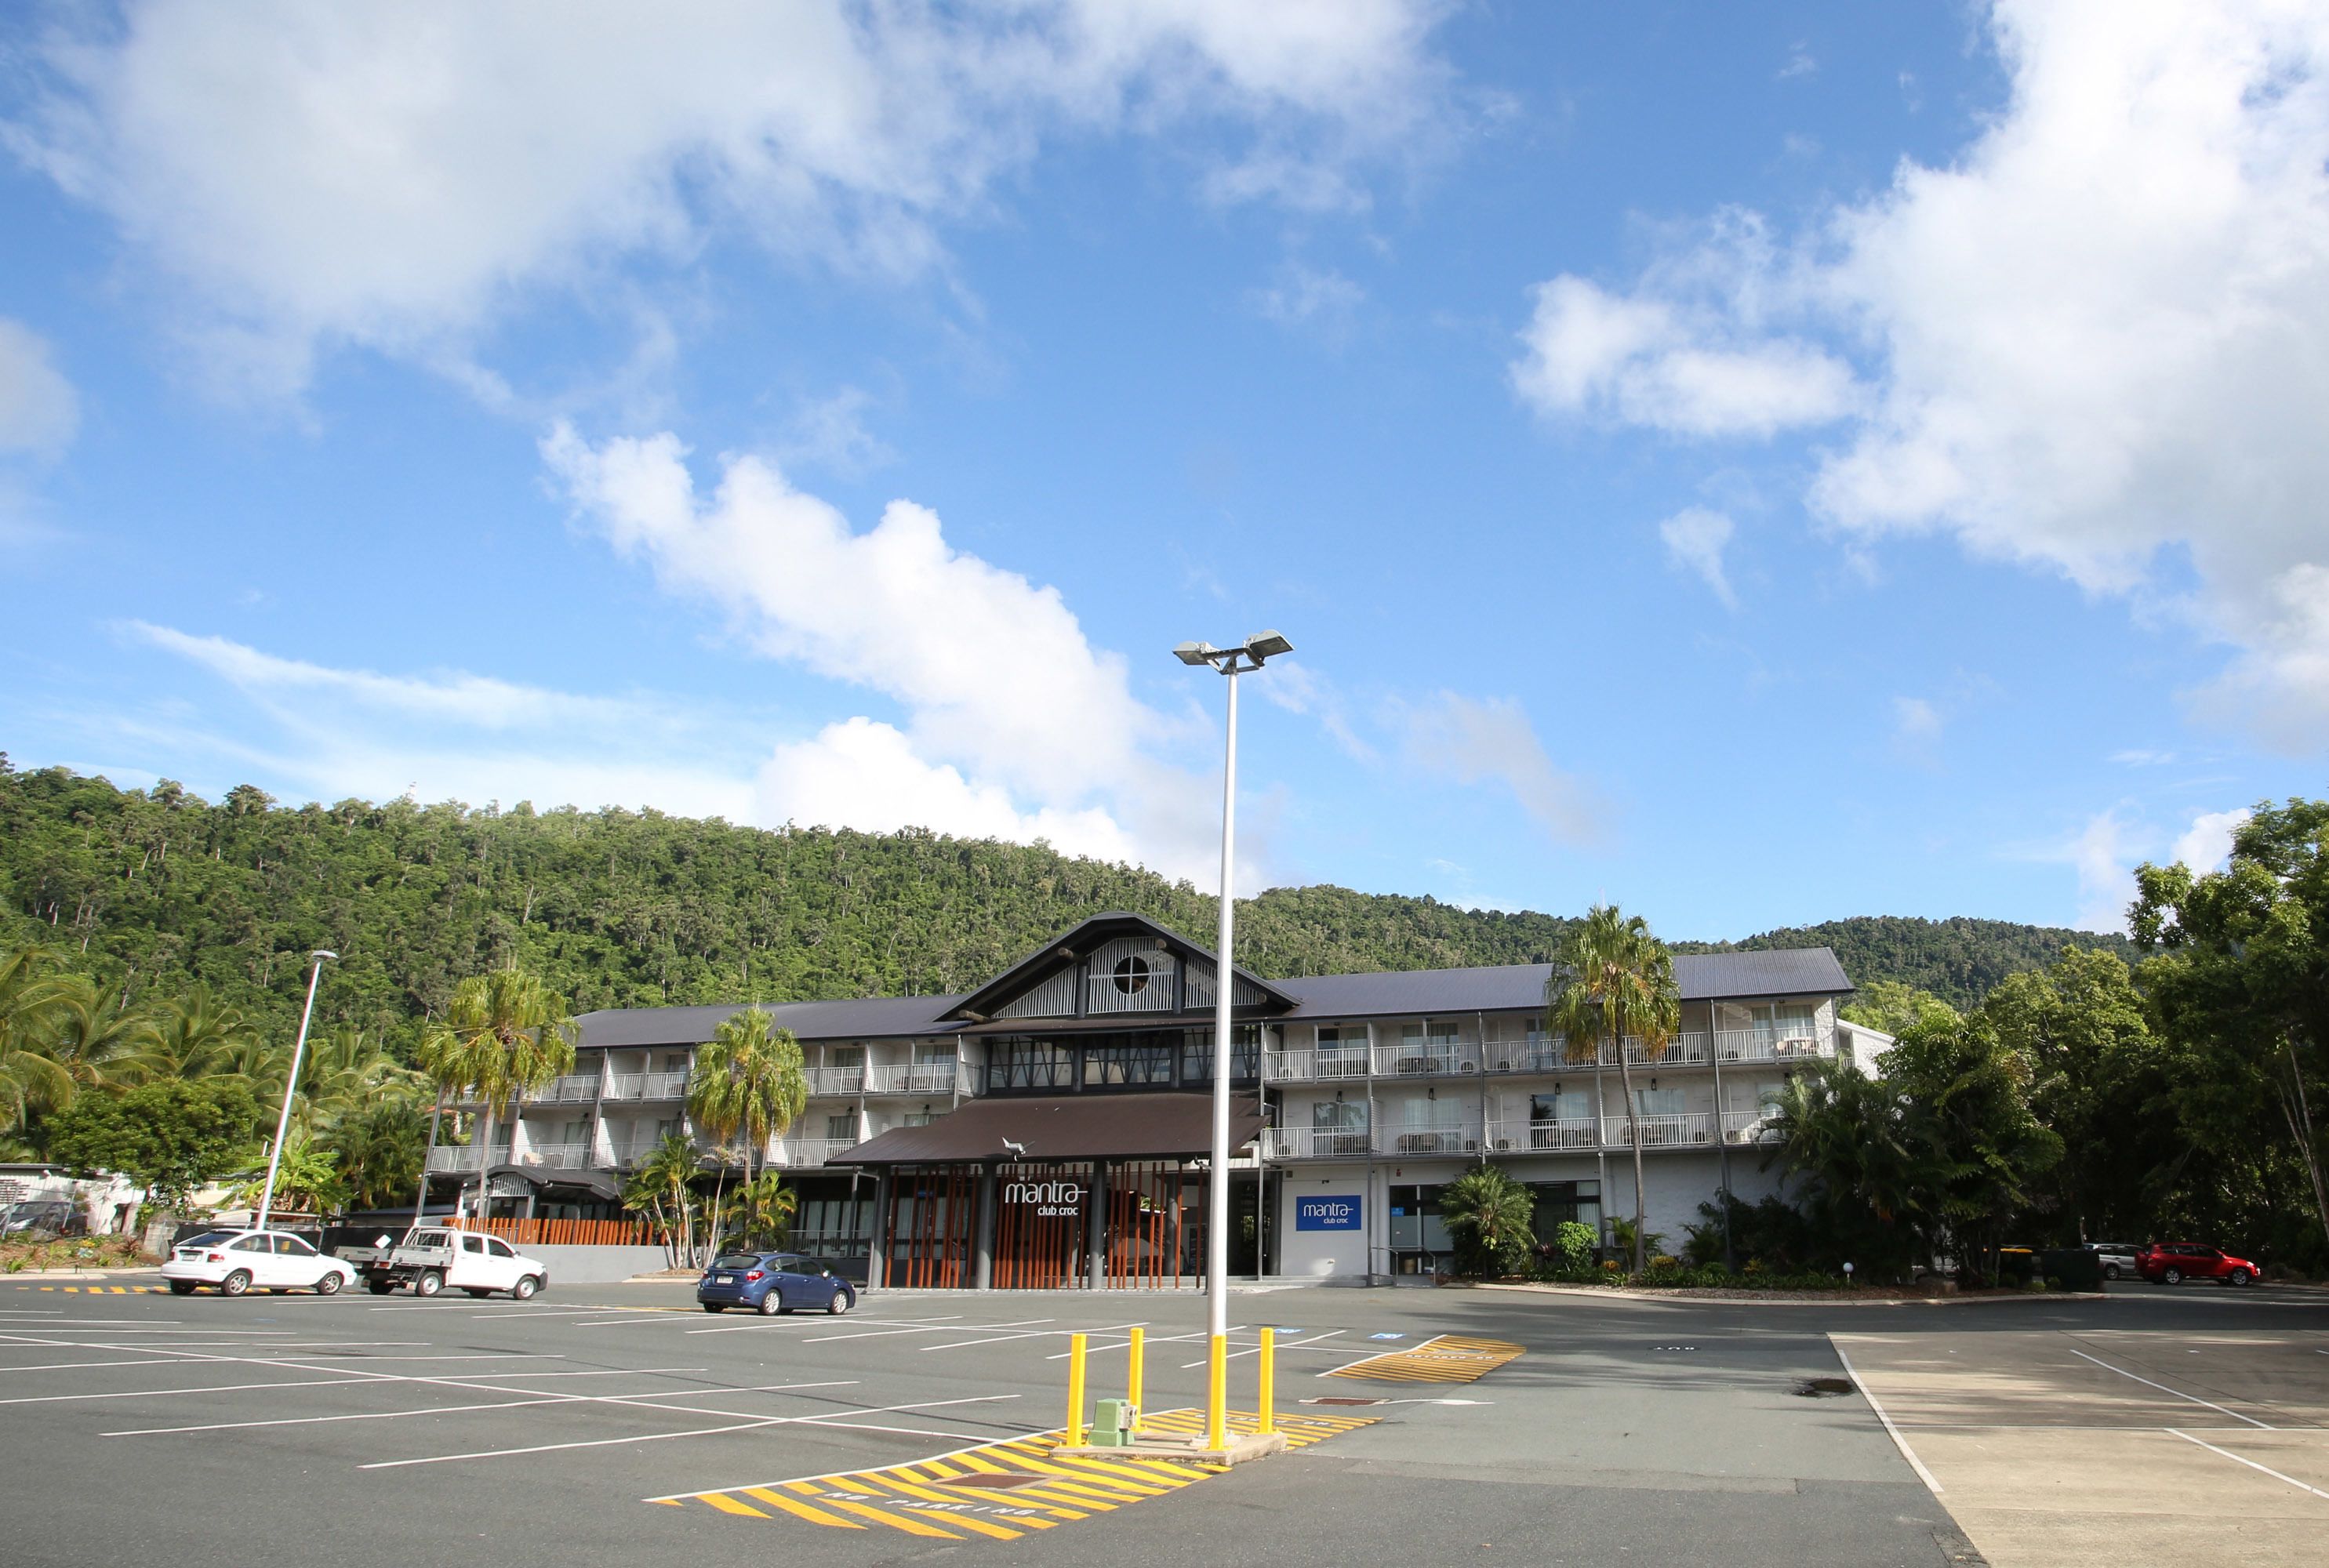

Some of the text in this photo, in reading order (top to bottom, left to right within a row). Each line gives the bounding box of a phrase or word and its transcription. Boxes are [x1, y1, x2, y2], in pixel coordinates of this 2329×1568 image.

[1005, 1180, 1088, 1203] mantra
[1037, 1205, 1078, 1215] club croc
[1303, 1203, 1353, 1217] mantra
[823, 1492, 1036, 1515] NO PARKING
